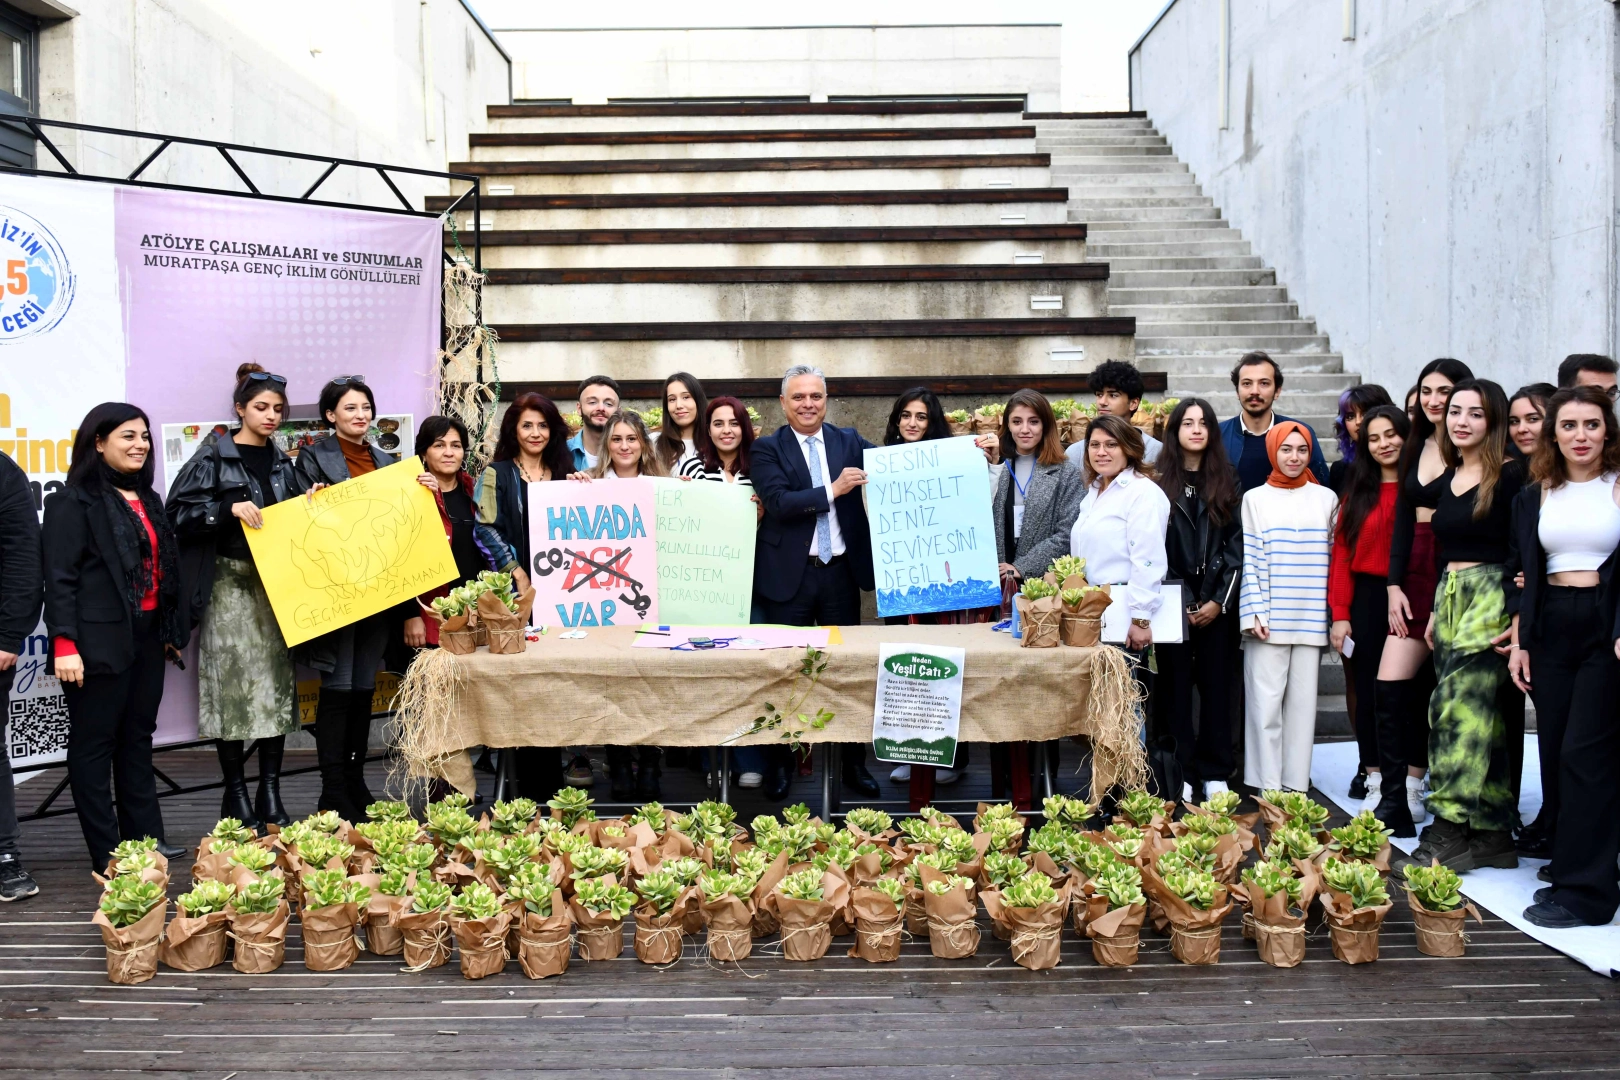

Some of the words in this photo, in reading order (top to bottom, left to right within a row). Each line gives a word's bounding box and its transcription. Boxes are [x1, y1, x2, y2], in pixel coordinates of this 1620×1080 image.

[140, 233, 204, 251] ATÖLYE
[209, 239, 319, 260] ÇALIŞMALARI
[322, 252, 338, 262] ve
[342, 251, 423, 269] SUNUMLAR
[143, 254, 240, 274] MURATPAŞA
[243, 261, 283, 278] GENÇ
[286, 263, 327, 279] İKLİM
[330, 267, 421, 286] GÖNÜLLÜLERİ
[875, 444, 940, 475] SESİNİ
[301, 481, 370, 520] HAREKETE
[875, 475, 964, 506] YÜKSELT
[546, 503, 647, 541] HAVADA
[877, 504, 940, 535] DENİZ
[880, 526, 978, 565] SEVİYESİNİ
[881, 563, 940, 590] DEĞİL
[555, 599, 617, 627] VAR
[891, 661, 917, 677] Yeşil
[918, 664, 941, 677] Çatı
[943, 666, 951, 678] ?
[911, 655, 932, 665] Neden
